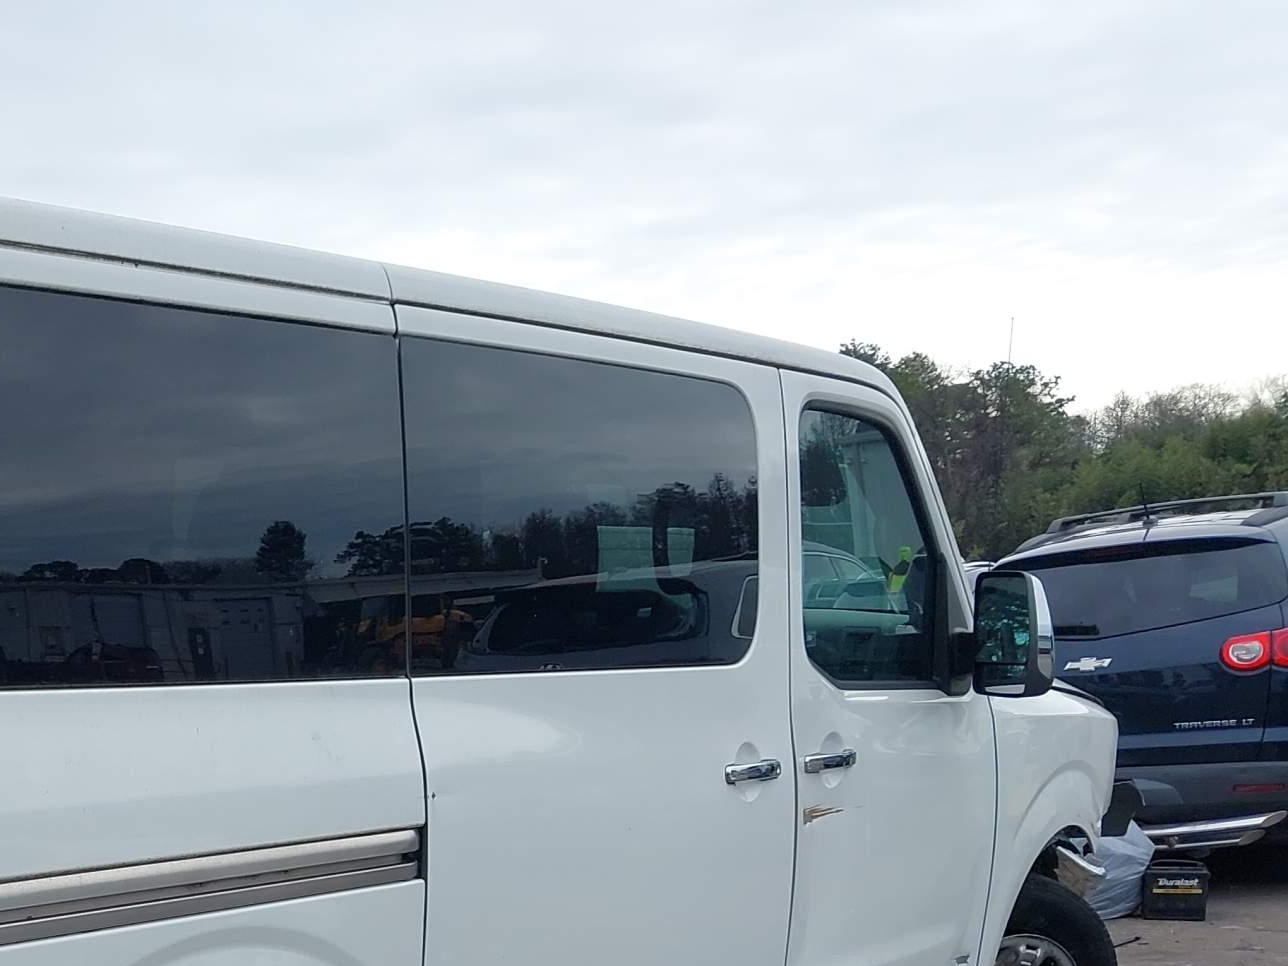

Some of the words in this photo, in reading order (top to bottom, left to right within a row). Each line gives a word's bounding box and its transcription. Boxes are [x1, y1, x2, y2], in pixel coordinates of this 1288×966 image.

[1173, 719, 1237, 729] TRAVERSE
[1242, 718, 1255, 726] LT
[1157, 878, 1199, 886] Duralast
